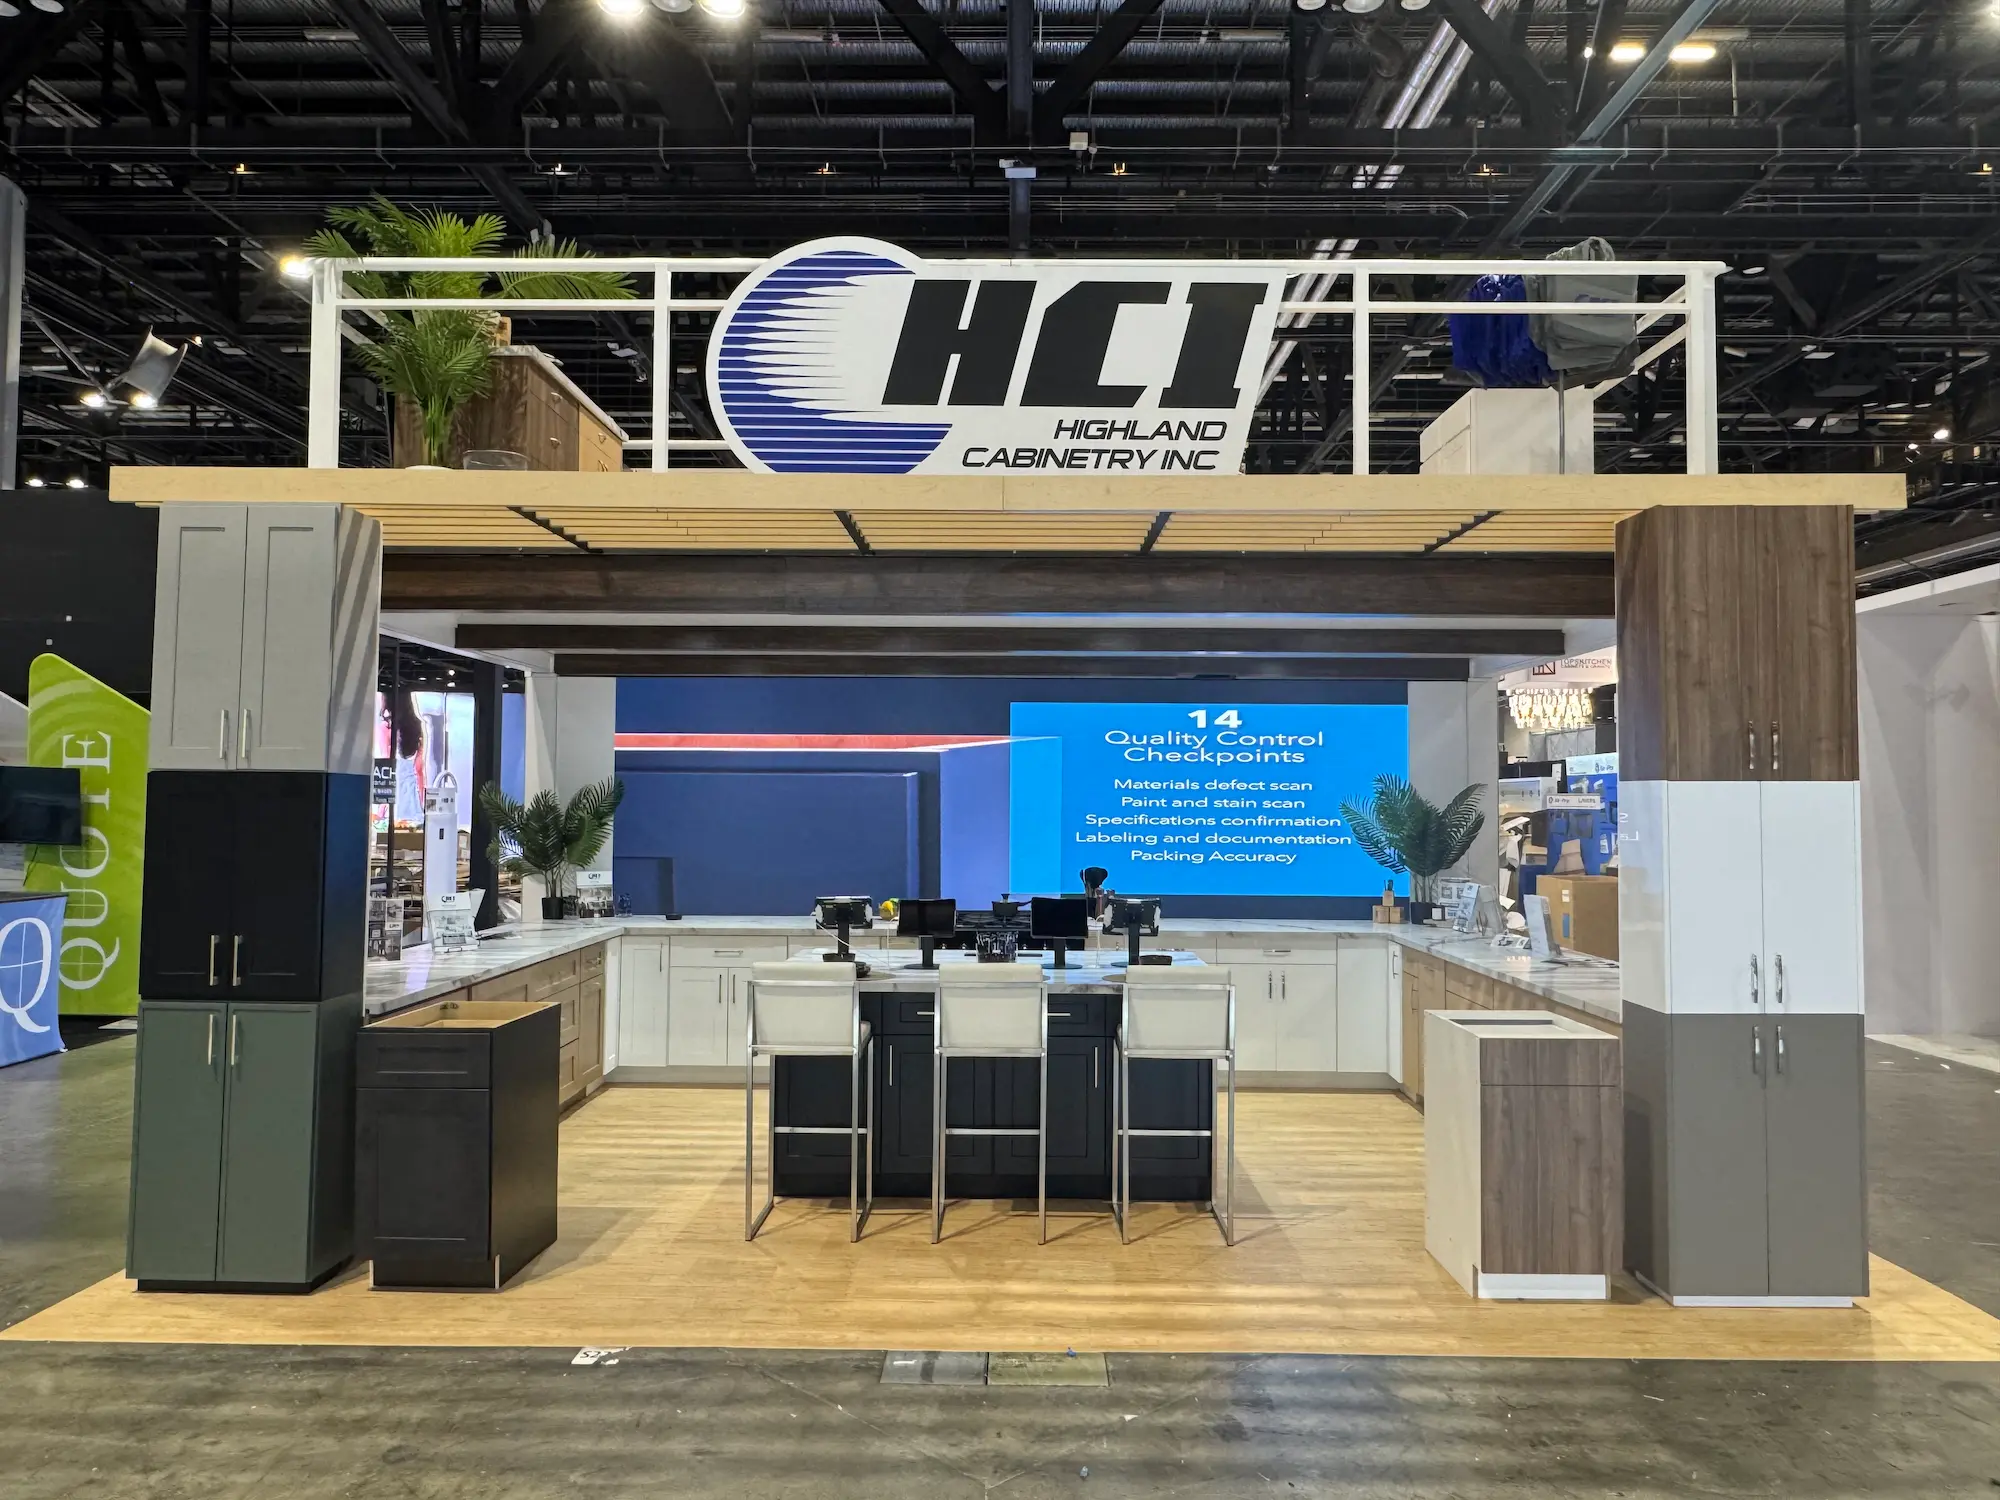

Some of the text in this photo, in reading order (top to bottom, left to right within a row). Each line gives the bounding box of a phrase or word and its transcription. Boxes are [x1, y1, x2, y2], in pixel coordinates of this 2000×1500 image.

[881, 279, 1270, 409] HCI
[1053, 419, 1228, 441] HIGHLAND
[962, 447, 1220, 471] CABINETRY INC
[1187, 709, 1243, 729] 14
[1104, 730, 1324, 749] Quality Control
[1123, 746, 1306, 766] Checkpoints
[1114, 778, 1314, 791] Materials defect scan
[1121, 796, 1305, 809] Paint and stain scan
[1085, 813, 1342, 827] Specifications confirmation
[1075, 831, 1352, 846] Labeling and documentation
[1131, 849, 1297, 865] Packing Accuracy
